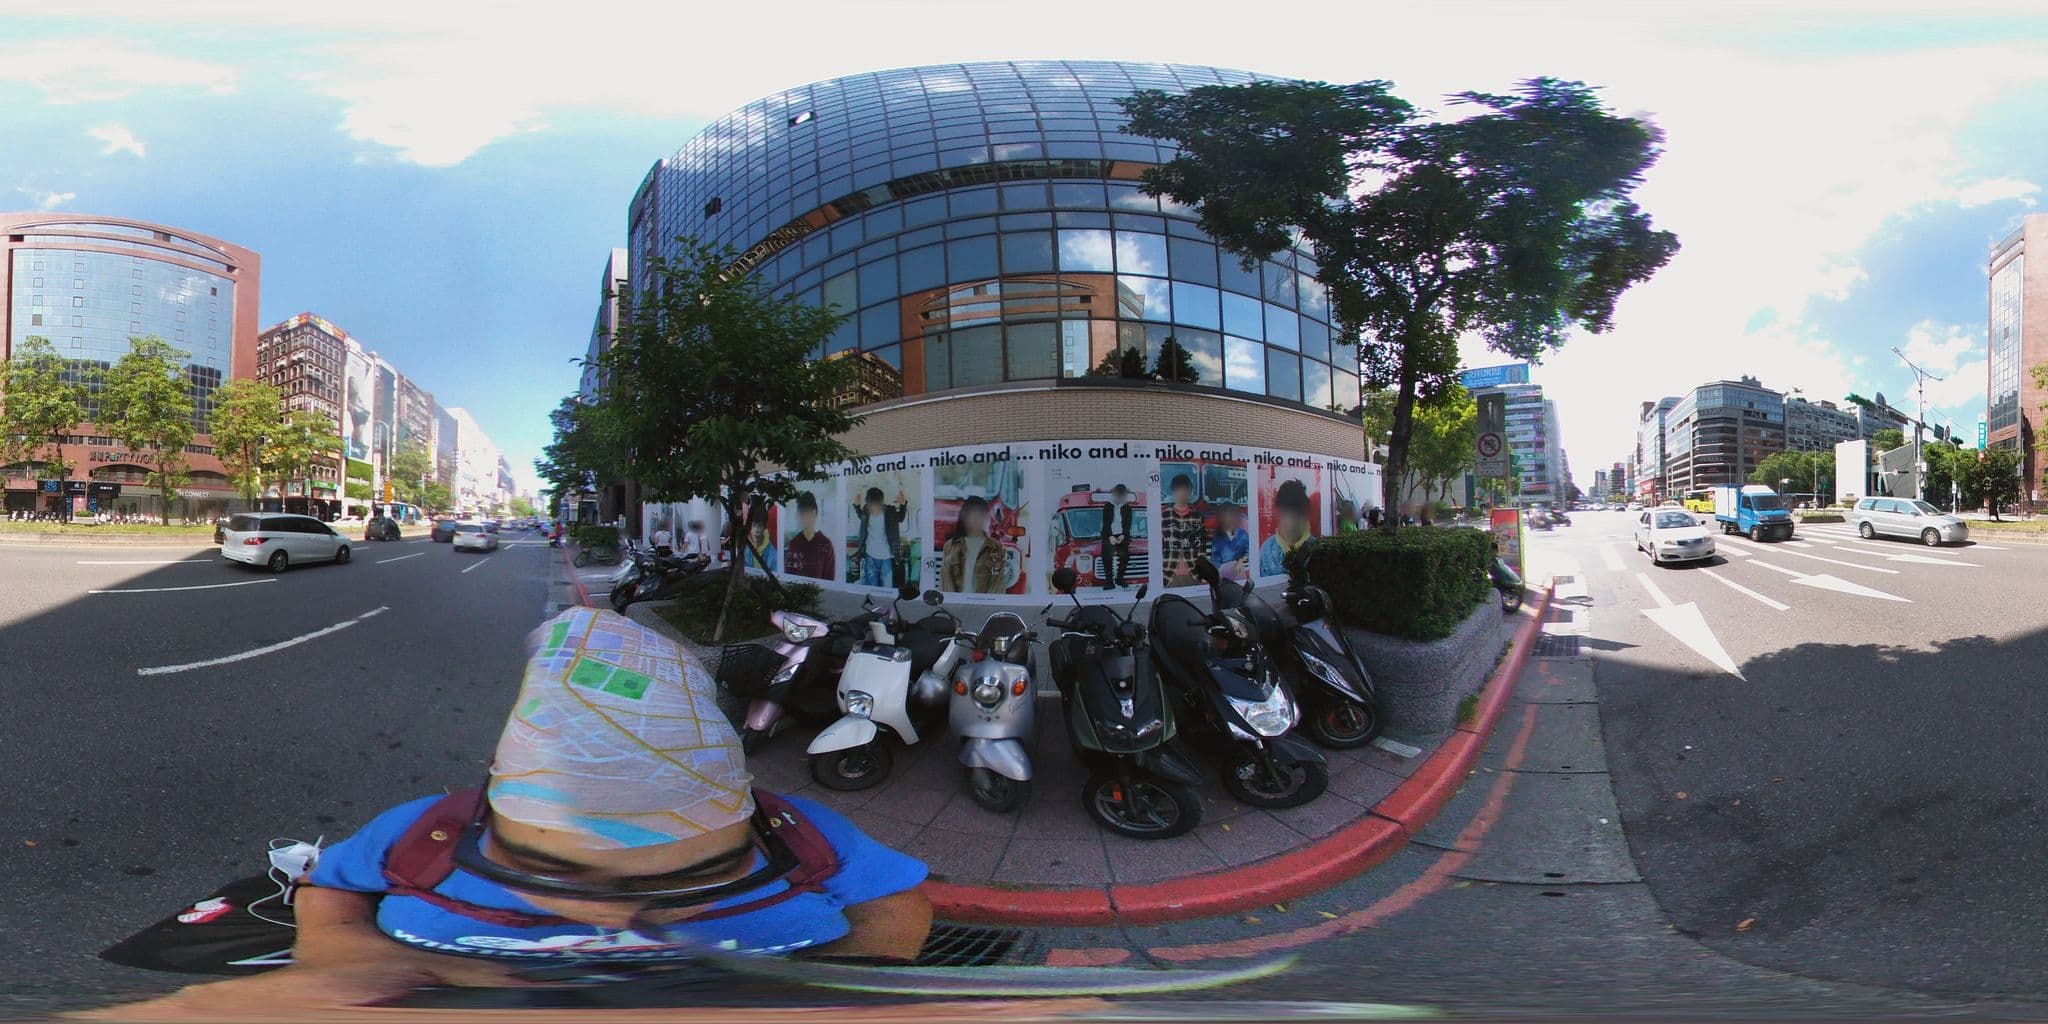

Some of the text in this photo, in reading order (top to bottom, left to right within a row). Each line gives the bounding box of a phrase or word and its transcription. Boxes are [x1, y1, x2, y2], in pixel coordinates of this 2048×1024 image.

[843, 461, 873, 476] niko
[876, 455, 906, 474] and
[929, 451, 967, 467] niko
[972, 445, 1010, 463] and
[1039, 443, 1082, 459] niko
[1088, 442, 1128, 459] and
[1155, 444, 1194, 460] niko
[1199, 447, 1233, 461] and
[1254, 451, 1284, 466] niko
[1287, 455, 1312, 469] and
[1326, 459, 1347, 472] niko
[1349, 464, 1366, 474] and
[1149, 473, 1160, 483] 10
[926, 560, 935, 569] 10
